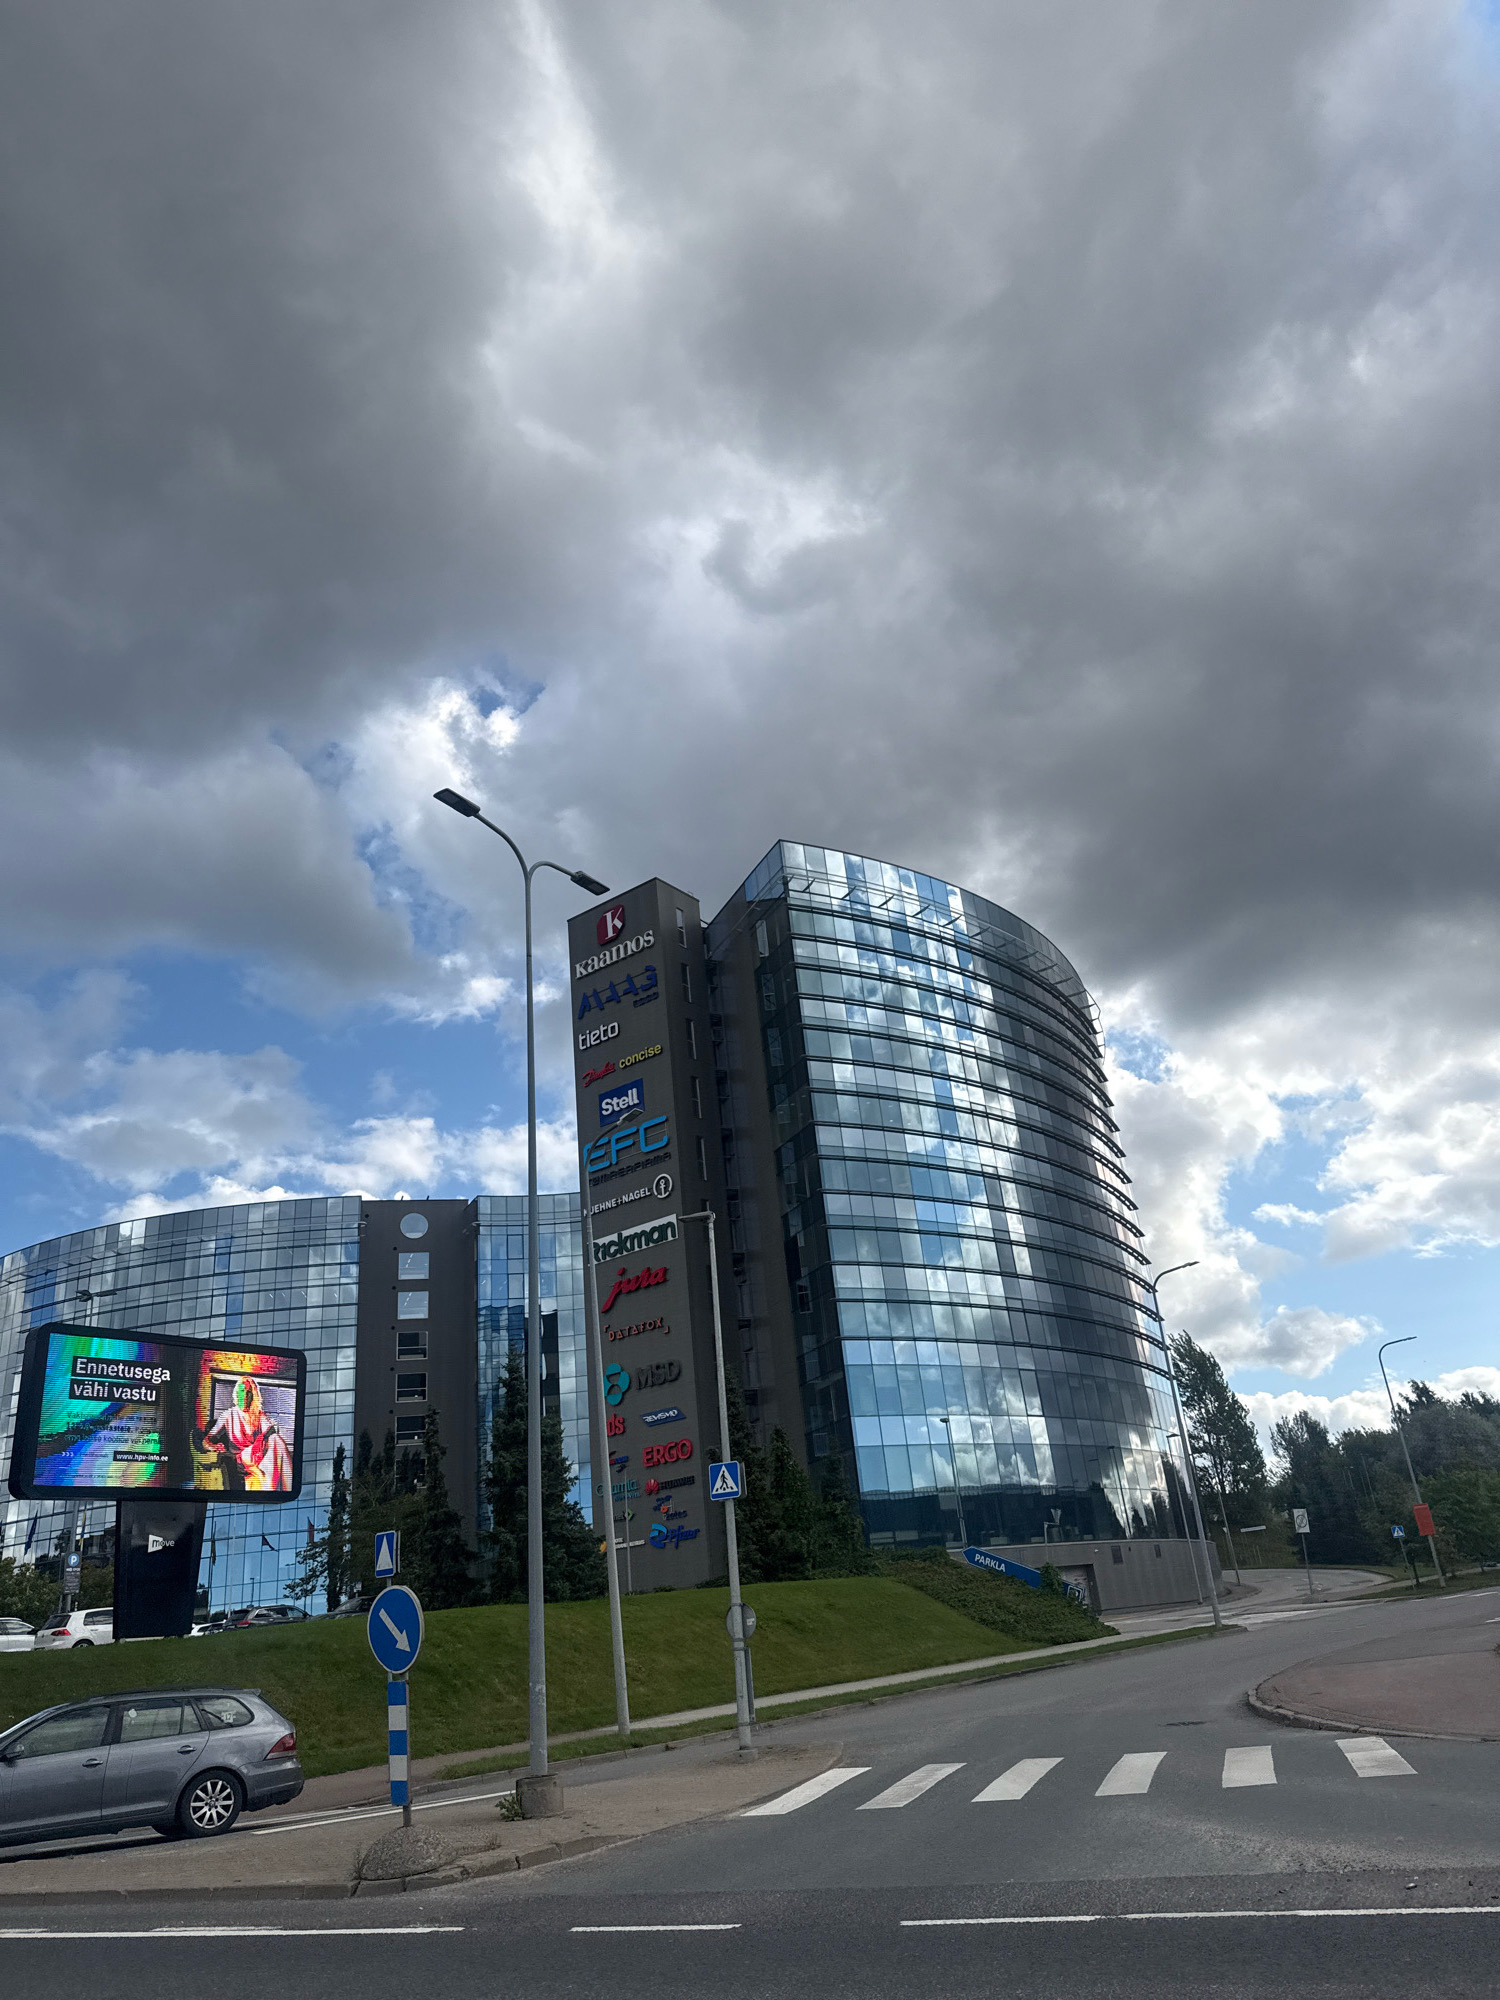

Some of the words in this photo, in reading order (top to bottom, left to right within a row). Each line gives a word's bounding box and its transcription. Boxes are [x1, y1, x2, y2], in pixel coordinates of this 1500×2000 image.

[602, 907, 624, 940] K
[578, 1021, 620, 1051] tieto
[618, 1043, 662, 1070] concise
[601, 1087, 640, 1116] Stell
[583, 1115, 669, 1173] EFC
[600, 1266, 668, 1314] jura
[75, 1357, 171, 1383] Ennetusega
[636, 1359, 681, 1391] MSD
[73, 1380, 109, 1398] vähi
[112, 1384, 156, 1402] vastu
[116, 1453, 169, 1462] www.hpv-info.ee
[643, 1438, 692, 1468] ERGO
[151, 1537, 175, 1550] move
[974, 1553, 1006, 1573] PARKLA
